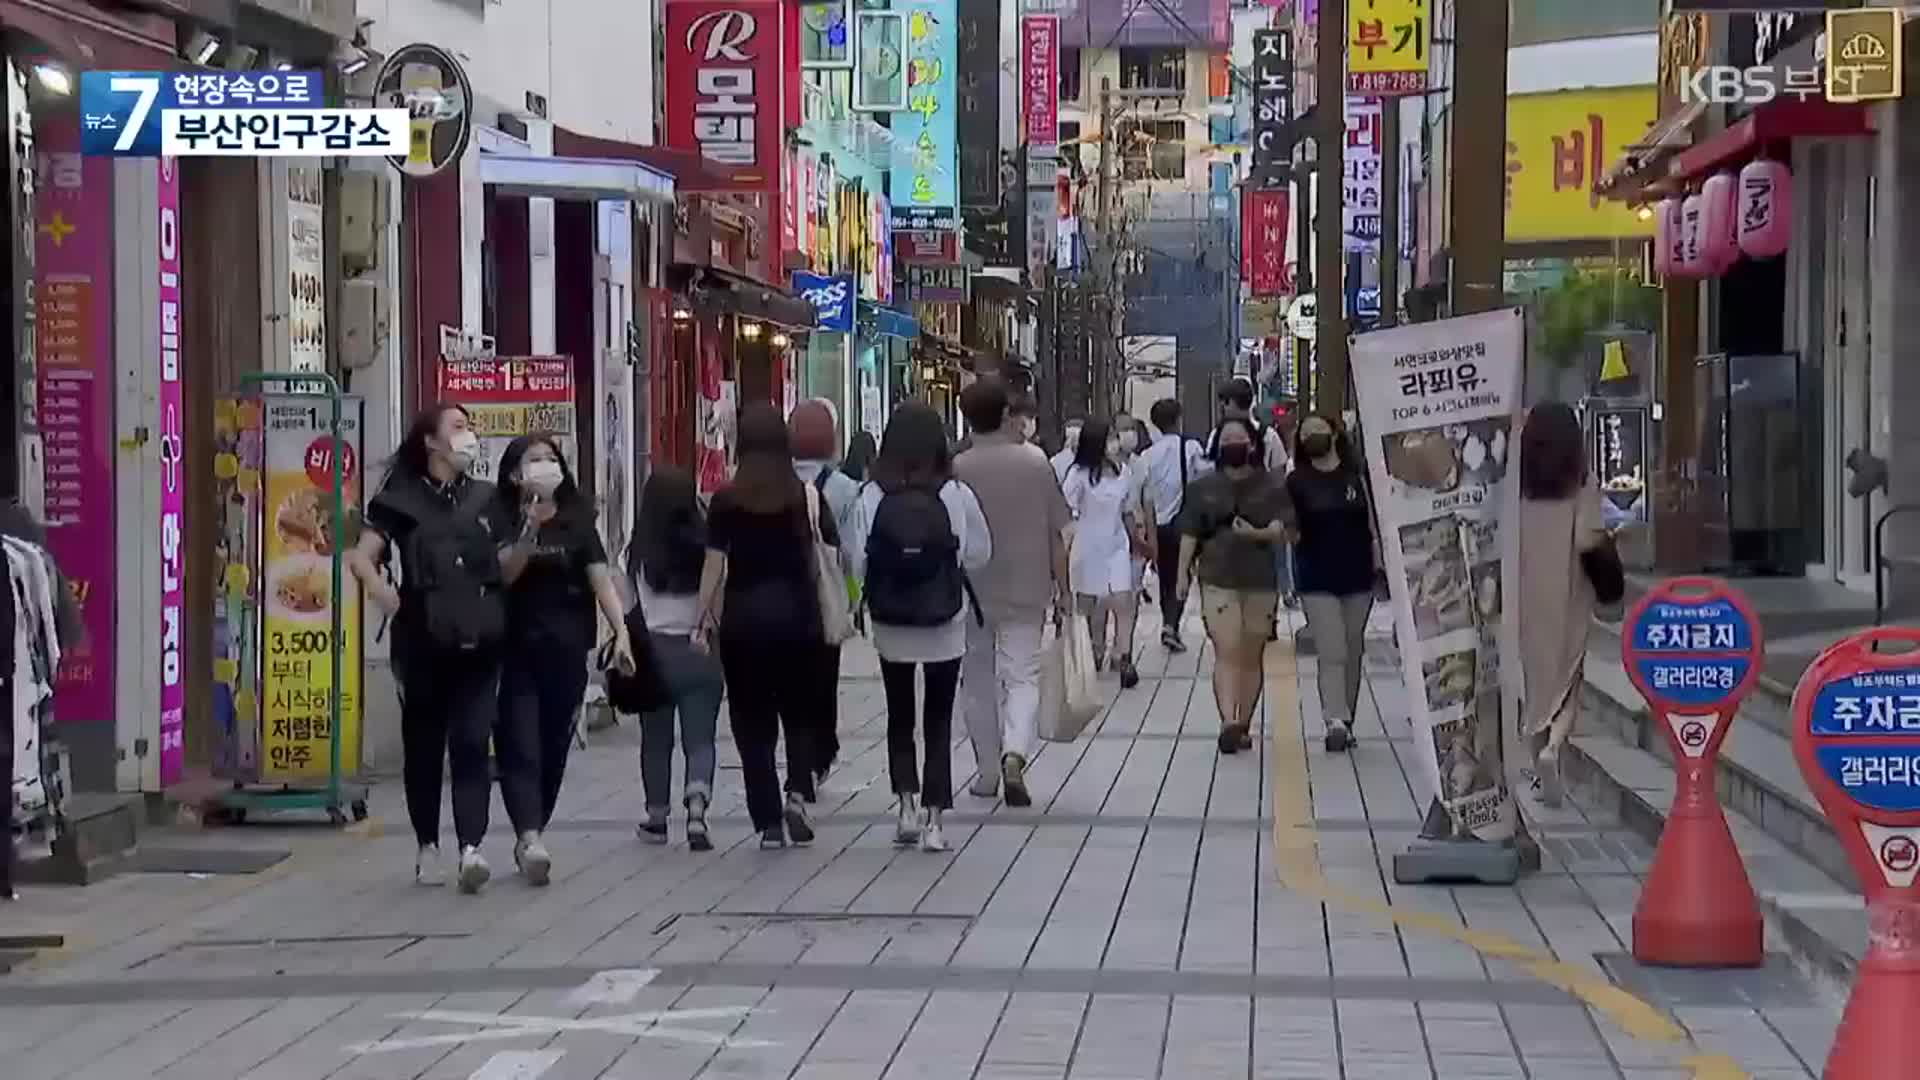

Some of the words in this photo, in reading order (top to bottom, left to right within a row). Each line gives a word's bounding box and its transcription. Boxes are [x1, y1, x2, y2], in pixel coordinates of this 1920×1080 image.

[695, 68, 757, 164] 모텔
[1392, 407, 1418, 421] TOP
[1646, 623, 1735, 649] 주차금지
[271, 660, 312, 684] 부터
[1652, 664, 1734, 688] 갤러리안경
[271, 717, 332, 742] 저렴한
[271, 747, 313, 769] 안주
